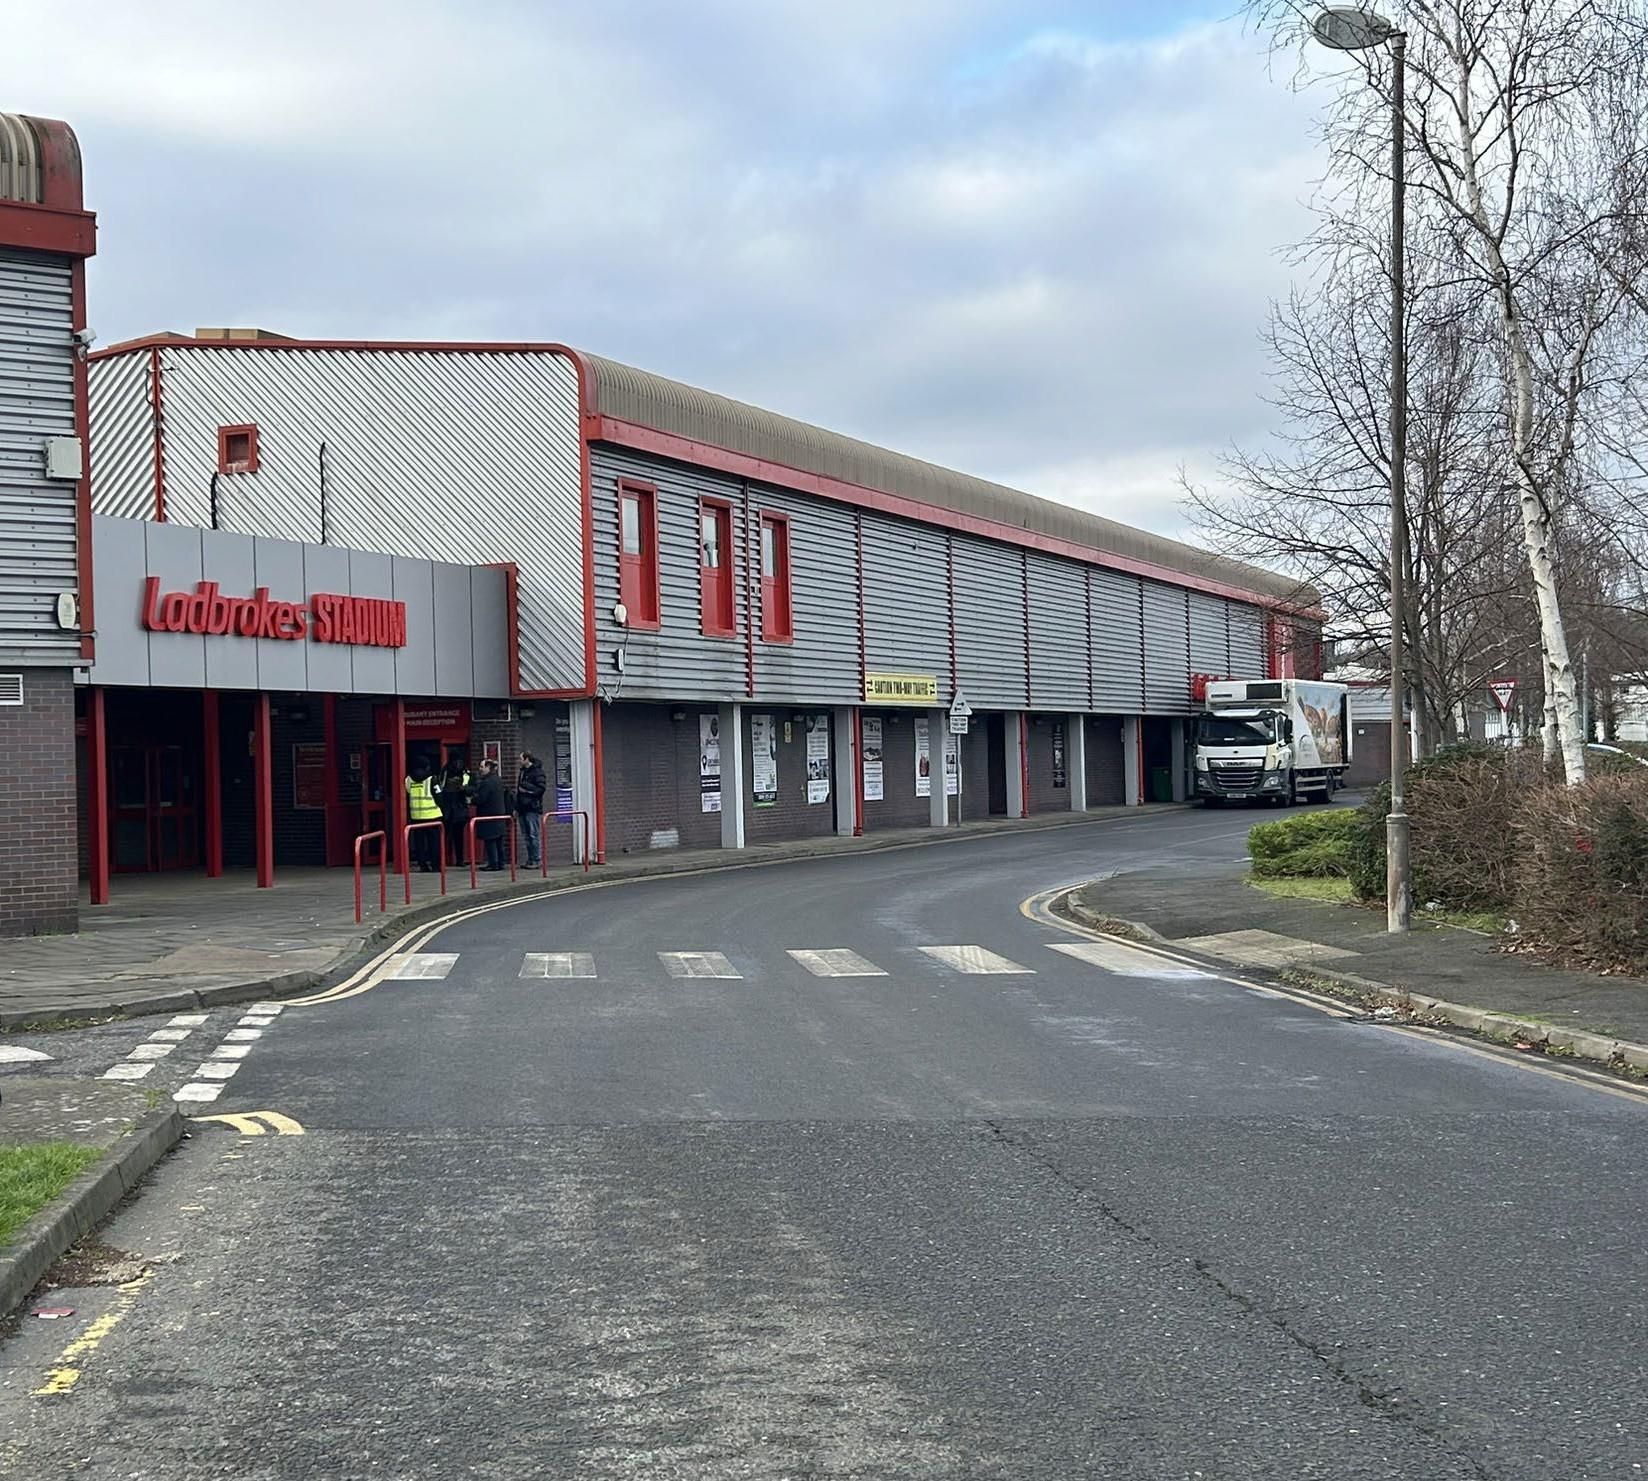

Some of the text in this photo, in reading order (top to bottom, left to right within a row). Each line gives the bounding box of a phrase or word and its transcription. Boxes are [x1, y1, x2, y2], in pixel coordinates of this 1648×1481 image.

[144, 576, 406, 648] Ladbrokes STADIUM
[874, 681, 892, 694] CAUTION
